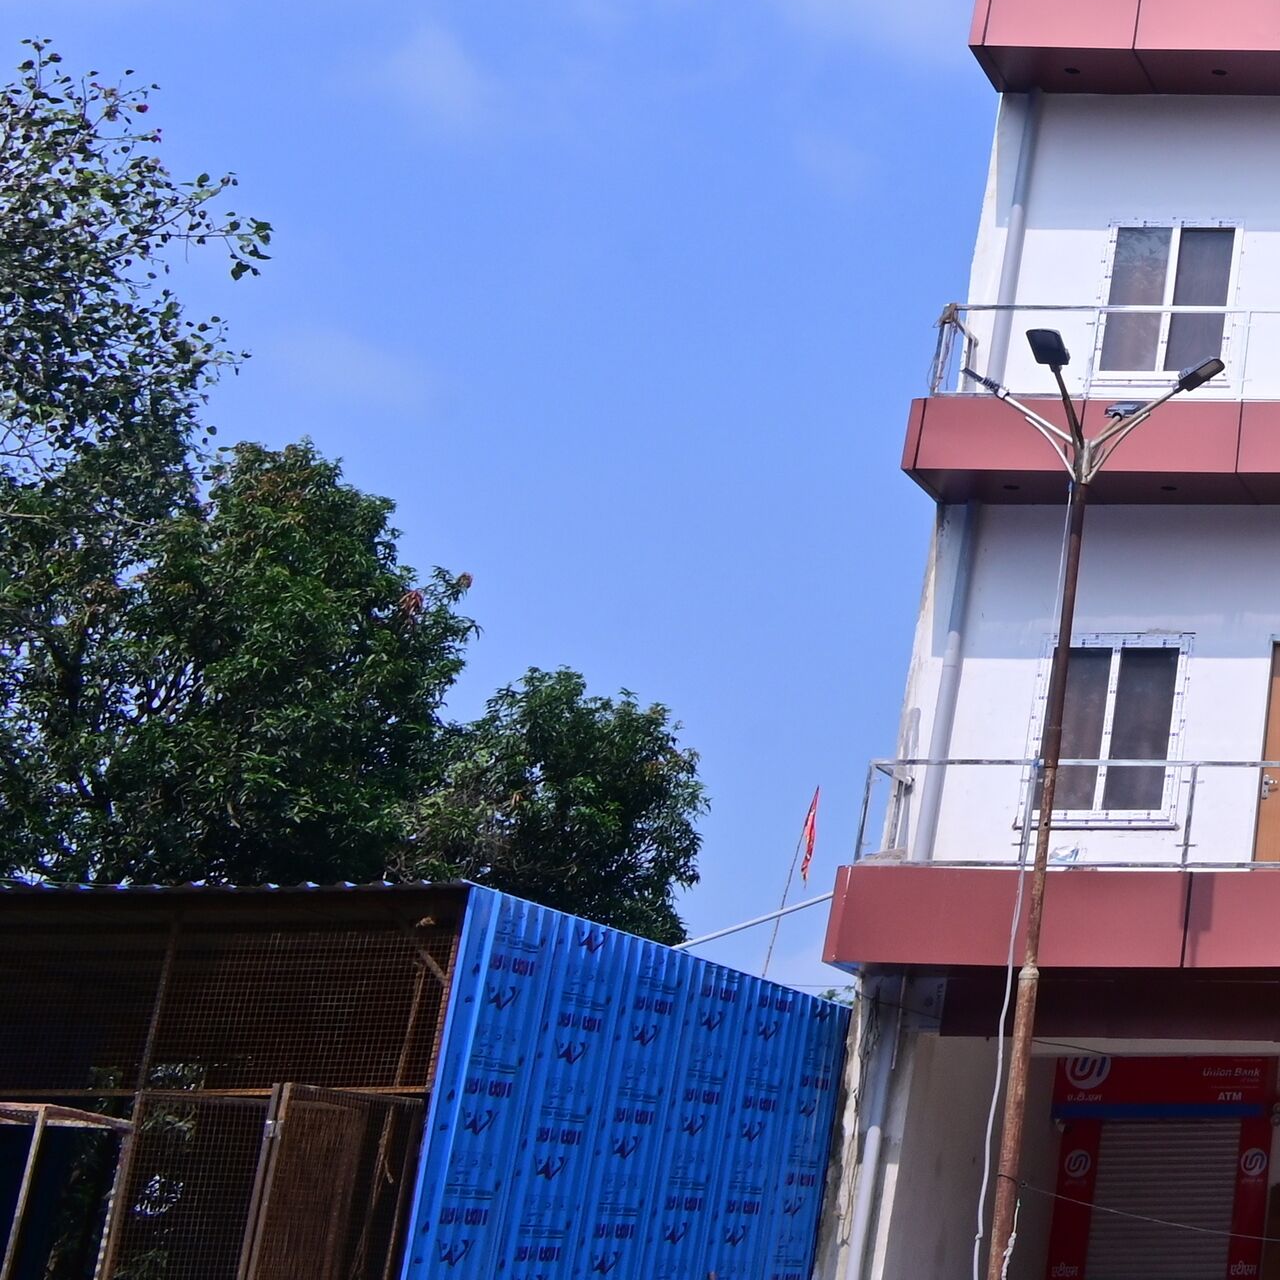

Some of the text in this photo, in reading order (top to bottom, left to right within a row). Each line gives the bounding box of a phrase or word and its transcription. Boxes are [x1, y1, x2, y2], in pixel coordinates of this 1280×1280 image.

[1203, 1067, 1260, 1077] Union Bank
[1217, 1091, 1242, 1101] ATM
